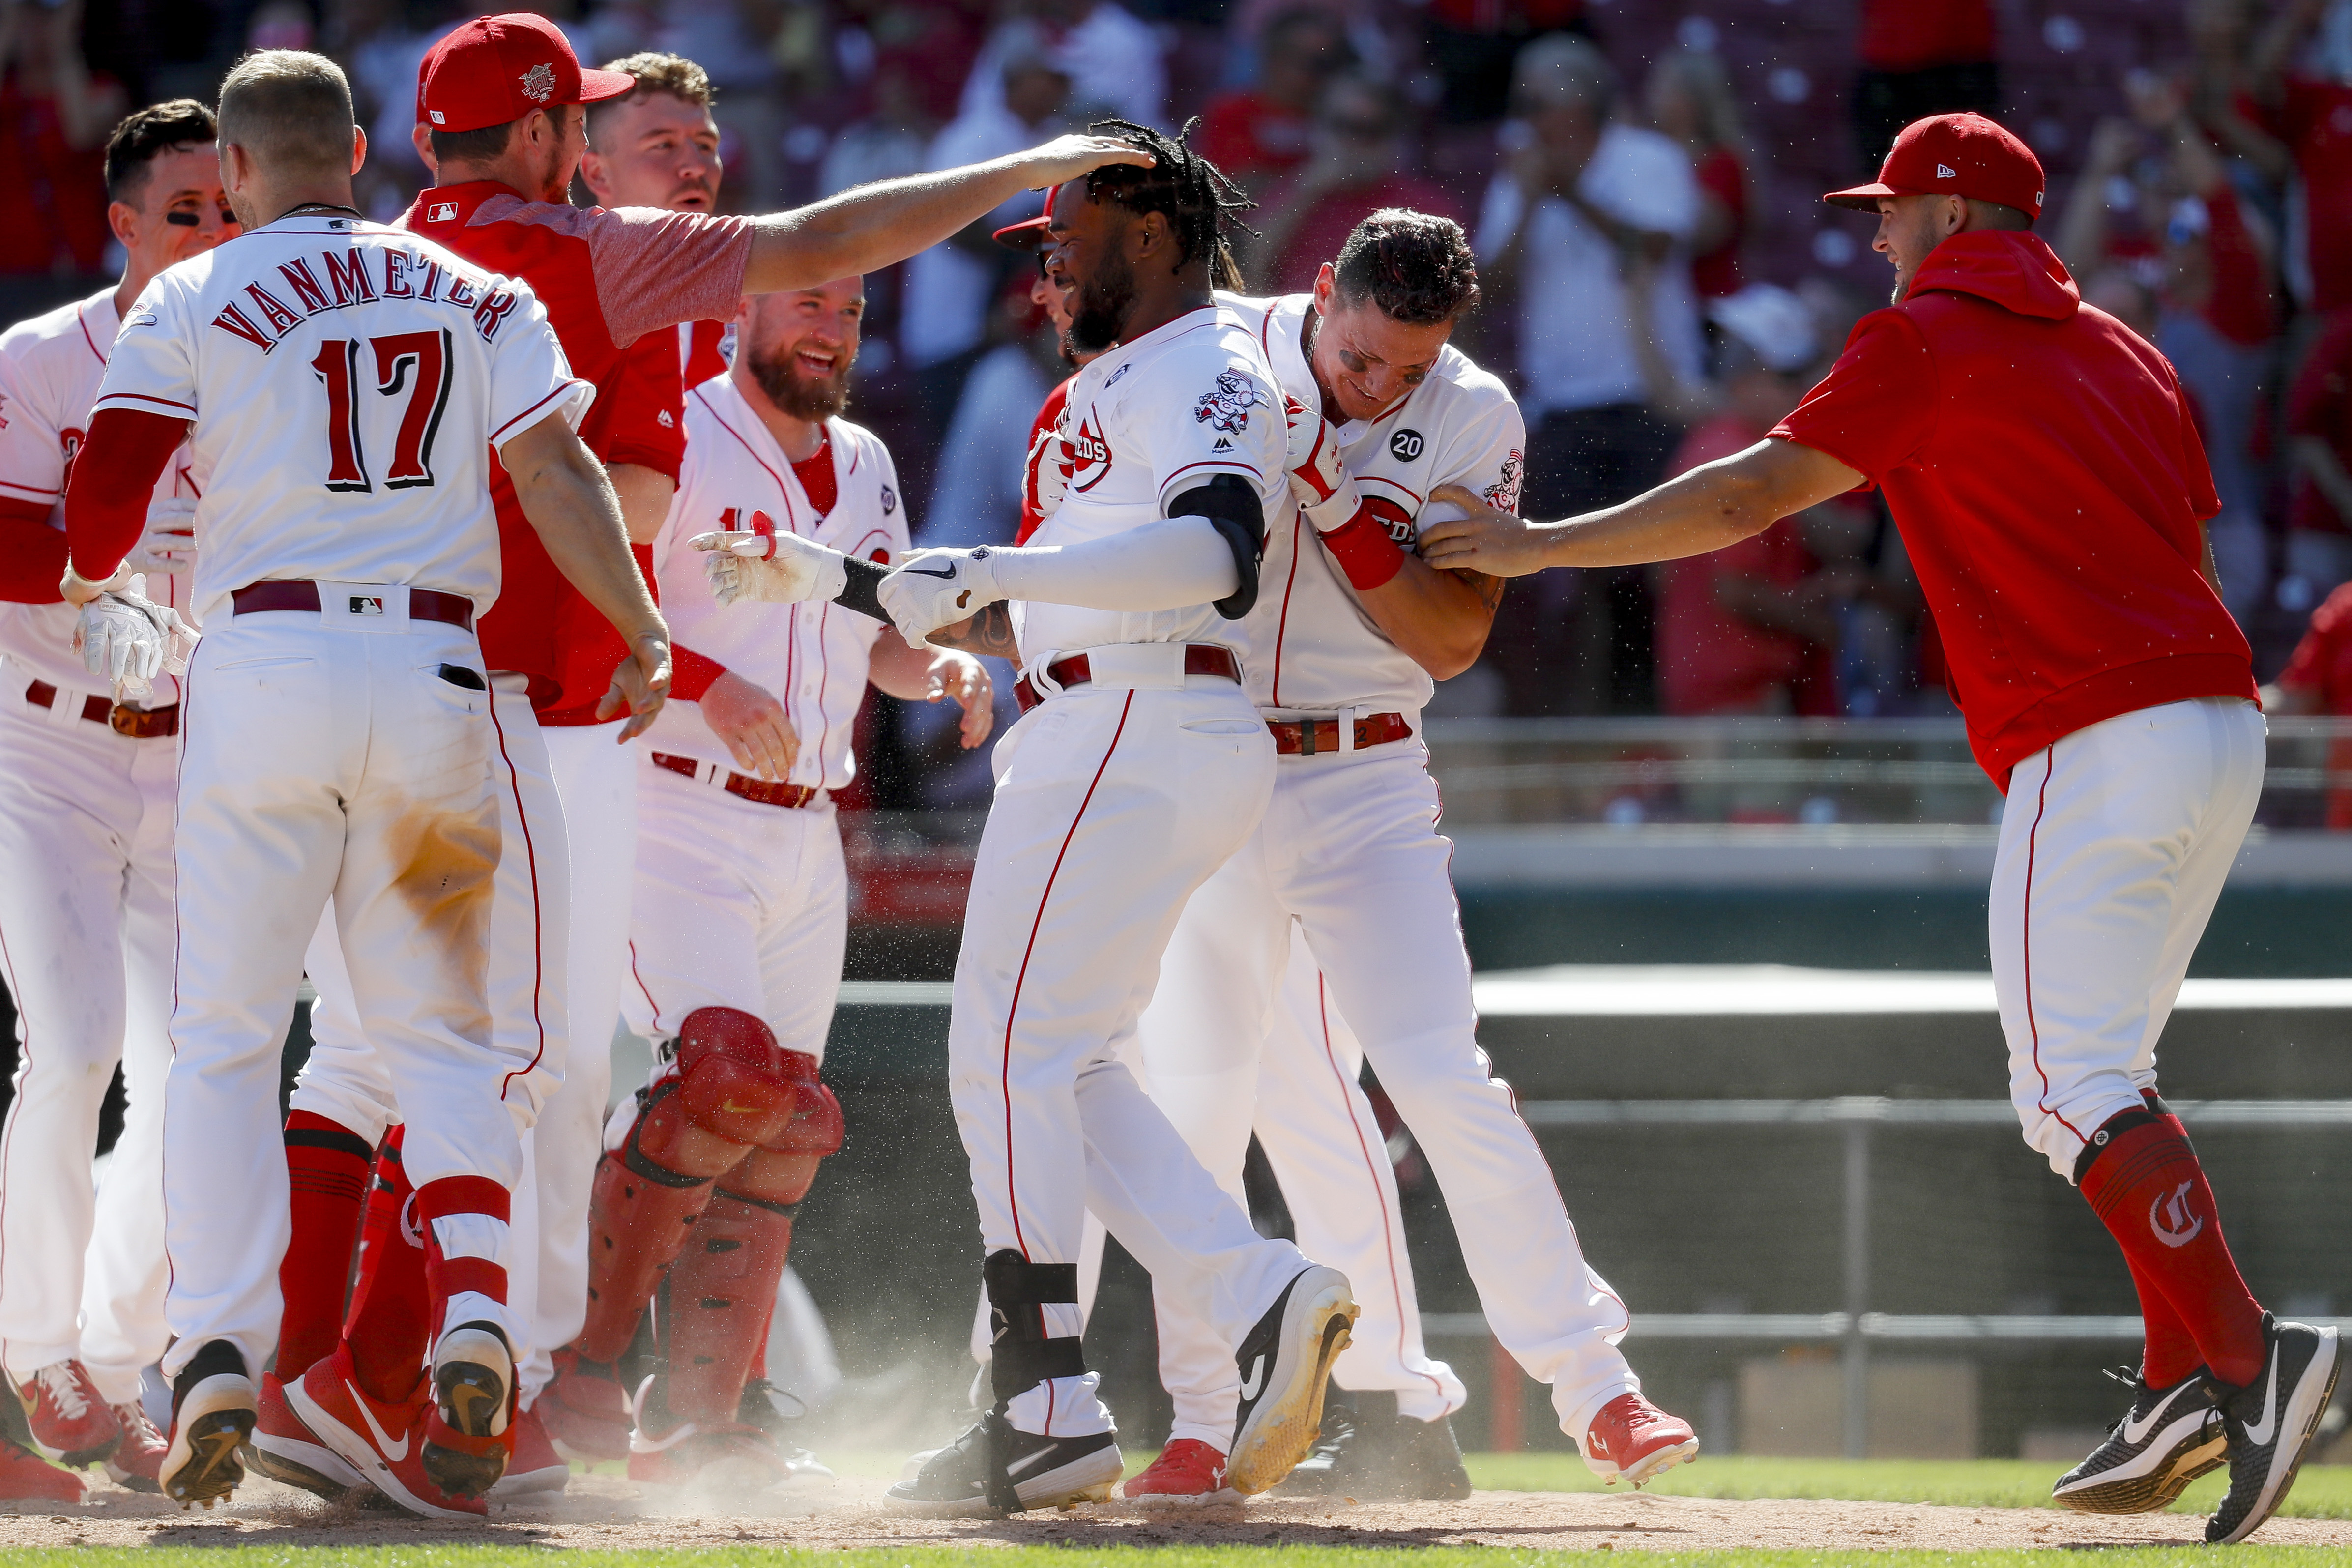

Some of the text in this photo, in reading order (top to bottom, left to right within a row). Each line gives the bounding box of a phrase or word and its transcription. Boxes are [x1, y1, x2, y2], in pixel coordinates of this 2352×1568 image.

[209, 246, 518, 355] VANMETER
[308, 326, 454, 493] 17
[1075, 435, 1108, 462] EDS
[1393, 433, 1422, 456] 20
[1354, 726, 1367, 742] 2
